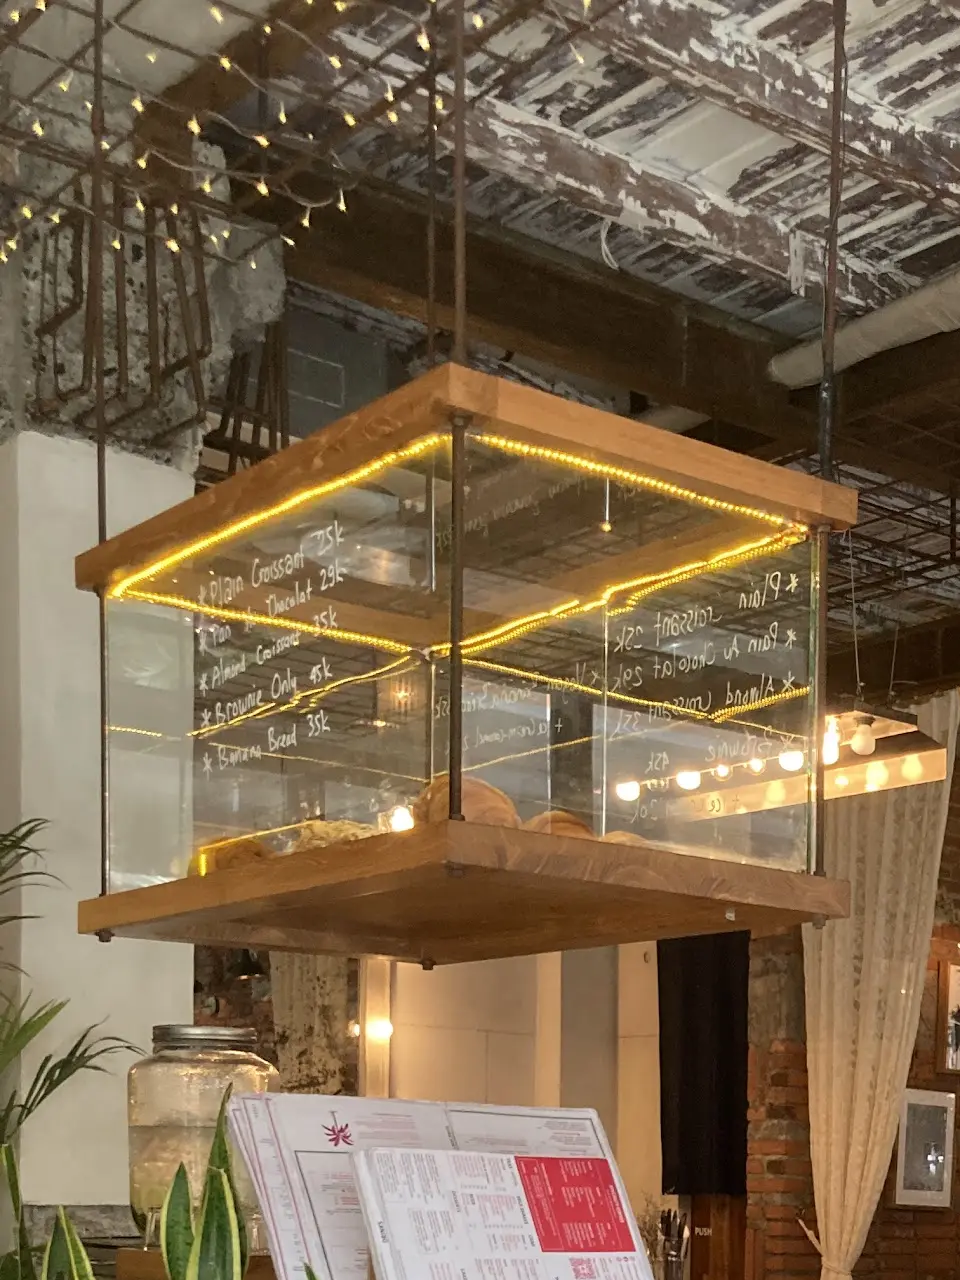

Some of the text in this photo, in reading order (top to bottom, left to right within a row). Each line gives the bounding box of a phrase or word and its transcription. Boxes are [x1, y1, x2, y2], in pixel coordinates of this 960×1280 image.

[210, 576, 244, 606] Plain
[251, 544, 304, 588] Croissant
[265, 578, 312, 618] Chocolat
[320, 559, 347, 591] 29k
[211, 653, 246, 690] Almond
[215, 656, 333, 726] Brownie Only 45k
[218, 709, 331, 770] Banana Bread 35k
[694, 1227, 713, 1237] PUSH
